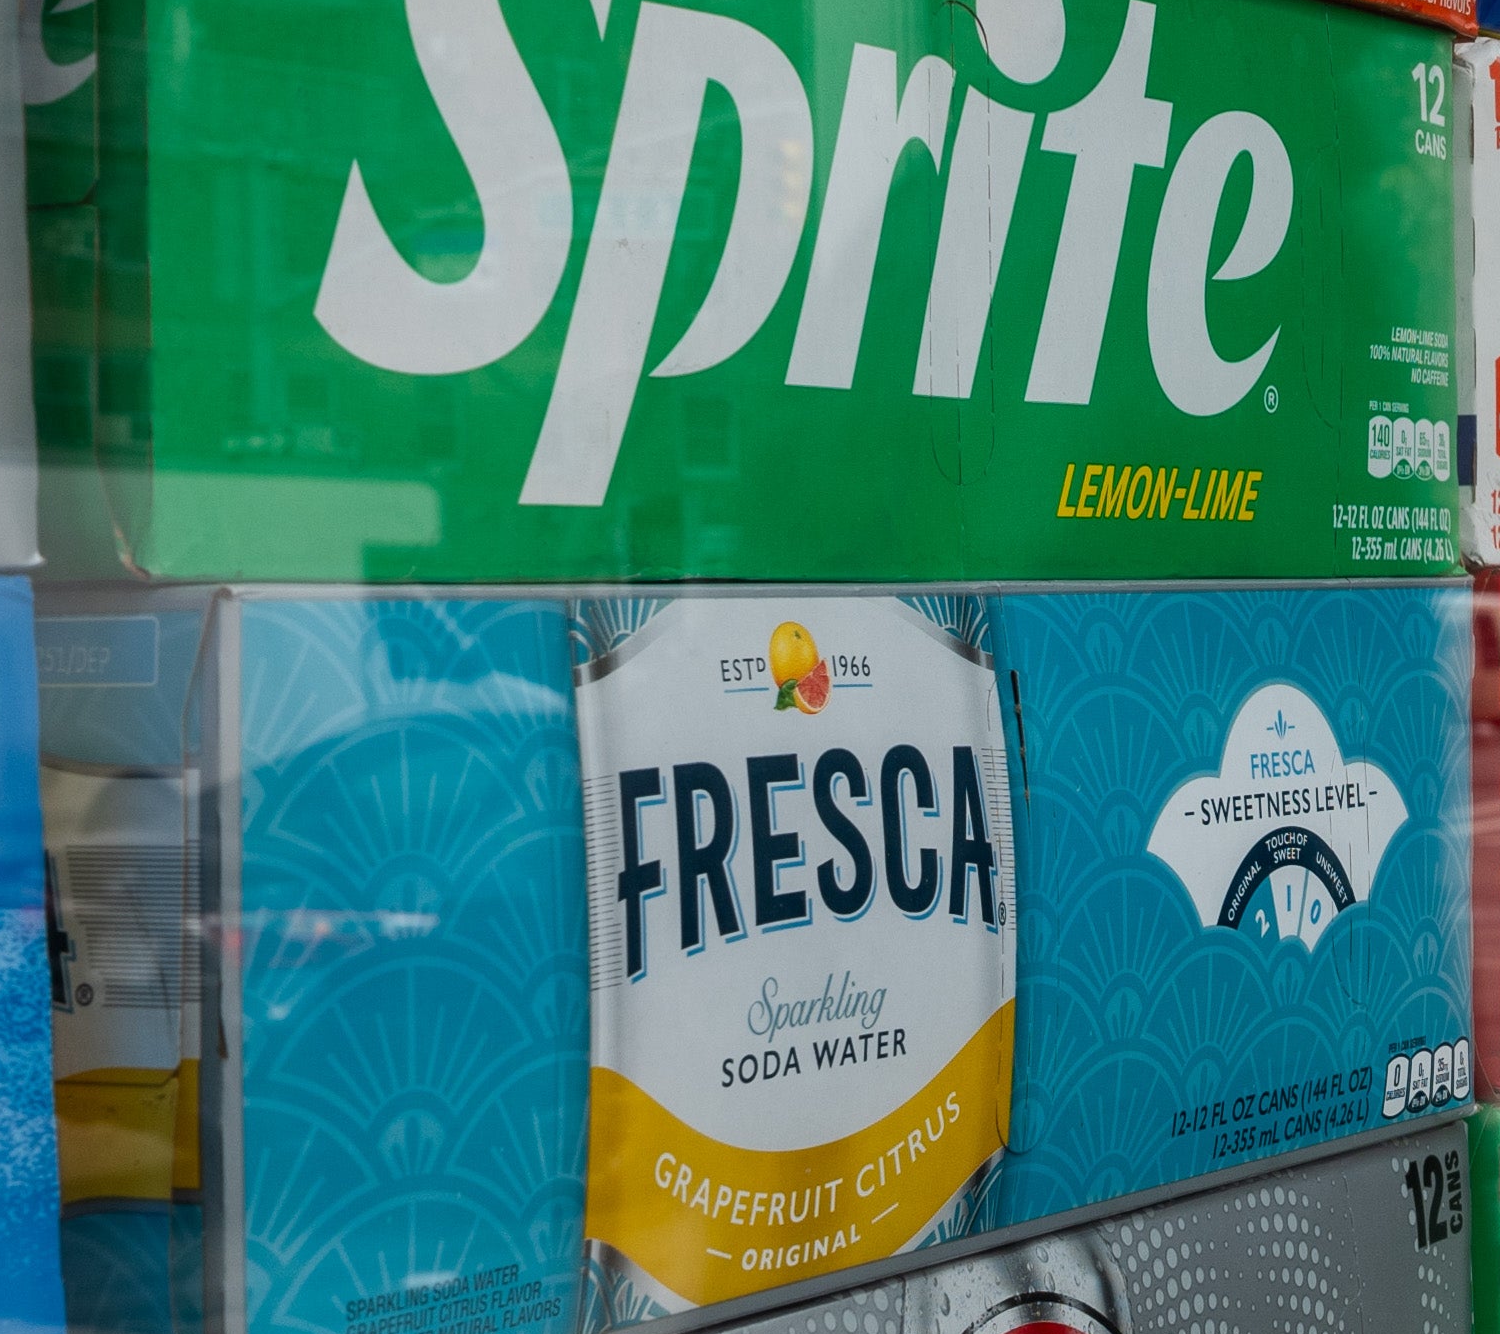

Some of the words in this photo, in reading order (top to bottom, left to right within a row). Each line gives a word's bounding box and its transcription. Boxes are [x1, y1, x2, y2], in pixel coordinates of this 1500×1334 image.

[1411, 62, 1446, 128] 12
[1415, 128, 1446, 160] CANS
[1057, 464, 1262, 523] LEMON-LIME
[831, 653, 872, 678] 1966
[1251, 749, 1315, 779] FRESCA
[1201, 788, 1310, 825] SWEETNESS
[1316, 782, 1365, 812] LEVEL
[616, 746, 998, 980] FRESCA
[1265, 831, 1296, 851] TOUCH
[1296, 834, 1308, 845] OF
[1273, 847, 1301, 864] SWEET
[1228, 861, 1261, 922] ORIGINAL
[1315, 851, 1348, 905] UNSWEET
[747, 969, 888, 1043] Sparkling
[721, 1044, 801, 1089] SODA
[811, 1026, 908, 1072] WATER
[653, 1149, 842, 1227] GRAPEFRUIT
[854, 1090, 963, 1199] CITRUS
[1405, 1154, 1448, 1249] 12
[1445, 1149, 1463, 1234] CANS
[741, 1230, 862, 1273] ORIGINAL
